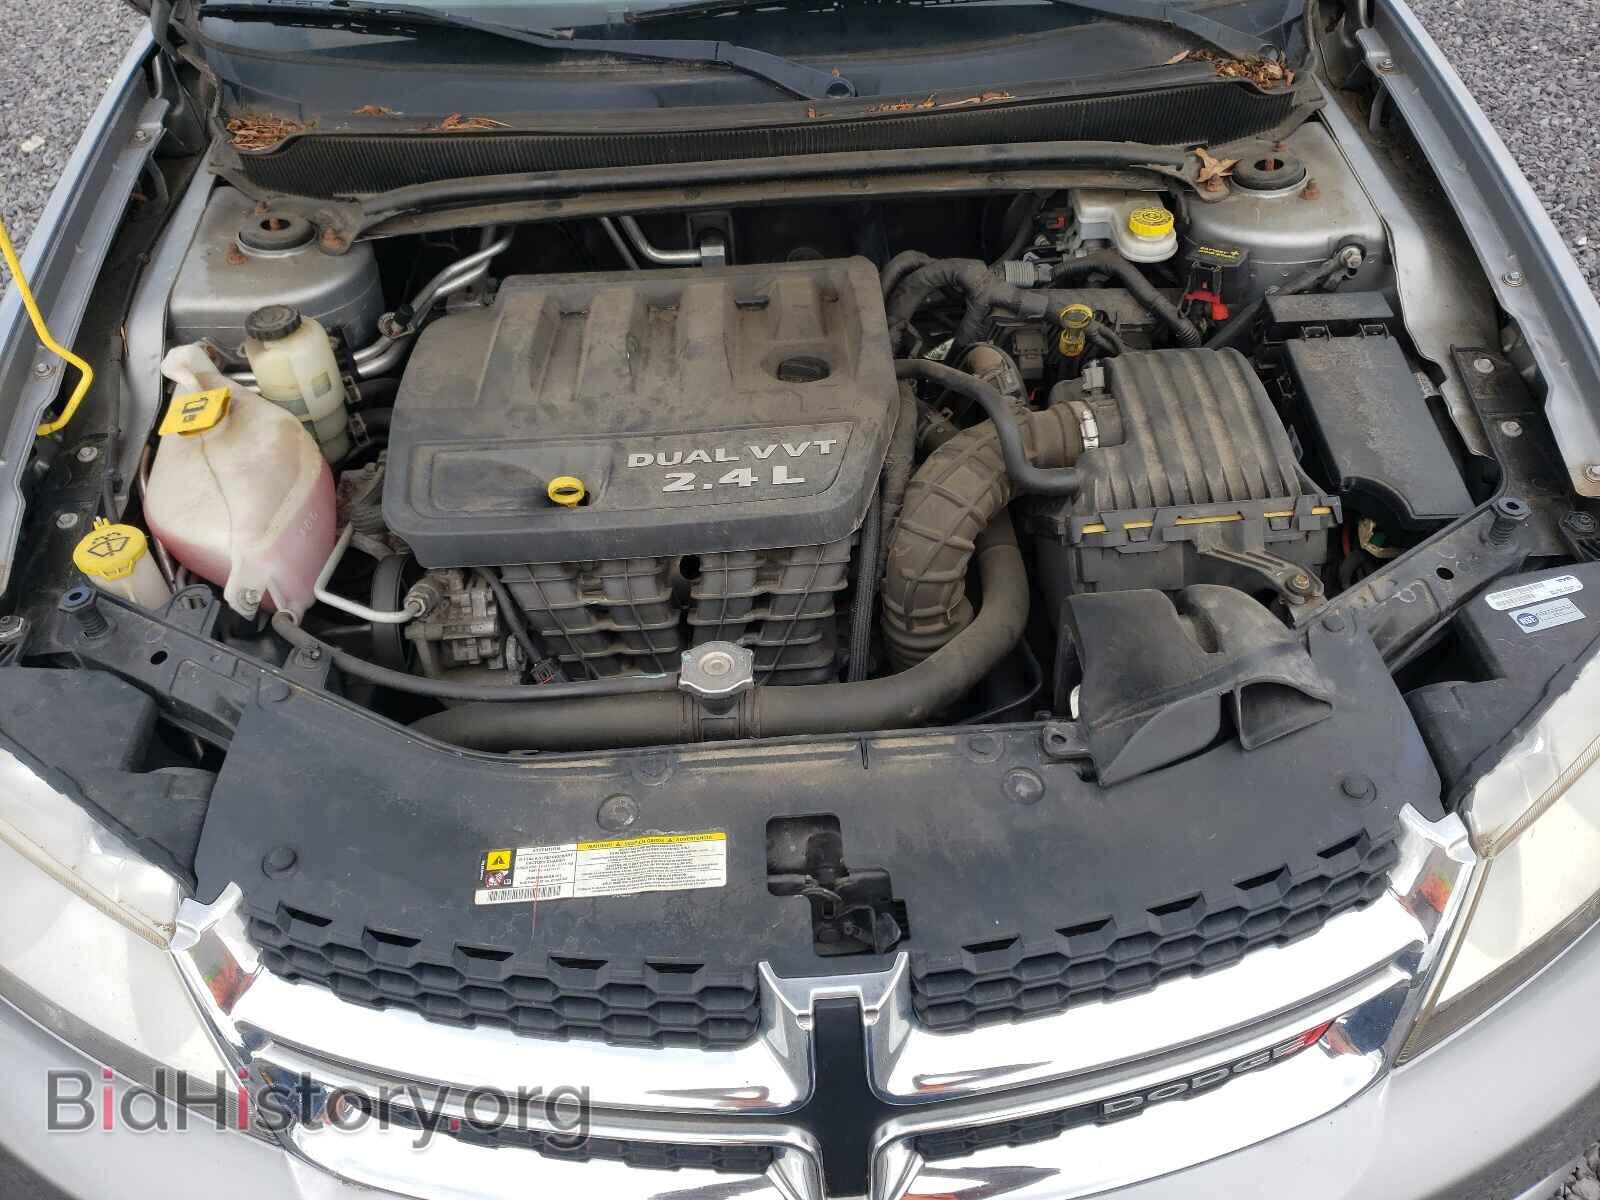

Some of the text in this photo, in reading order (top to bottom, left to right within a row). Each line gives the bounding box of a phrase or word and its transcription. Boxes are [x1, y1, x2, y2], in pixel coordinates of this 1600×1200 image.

[627, 439, 837, 468] DUAL VVT
[1103, 1036, 1305, 1115] DODGE
